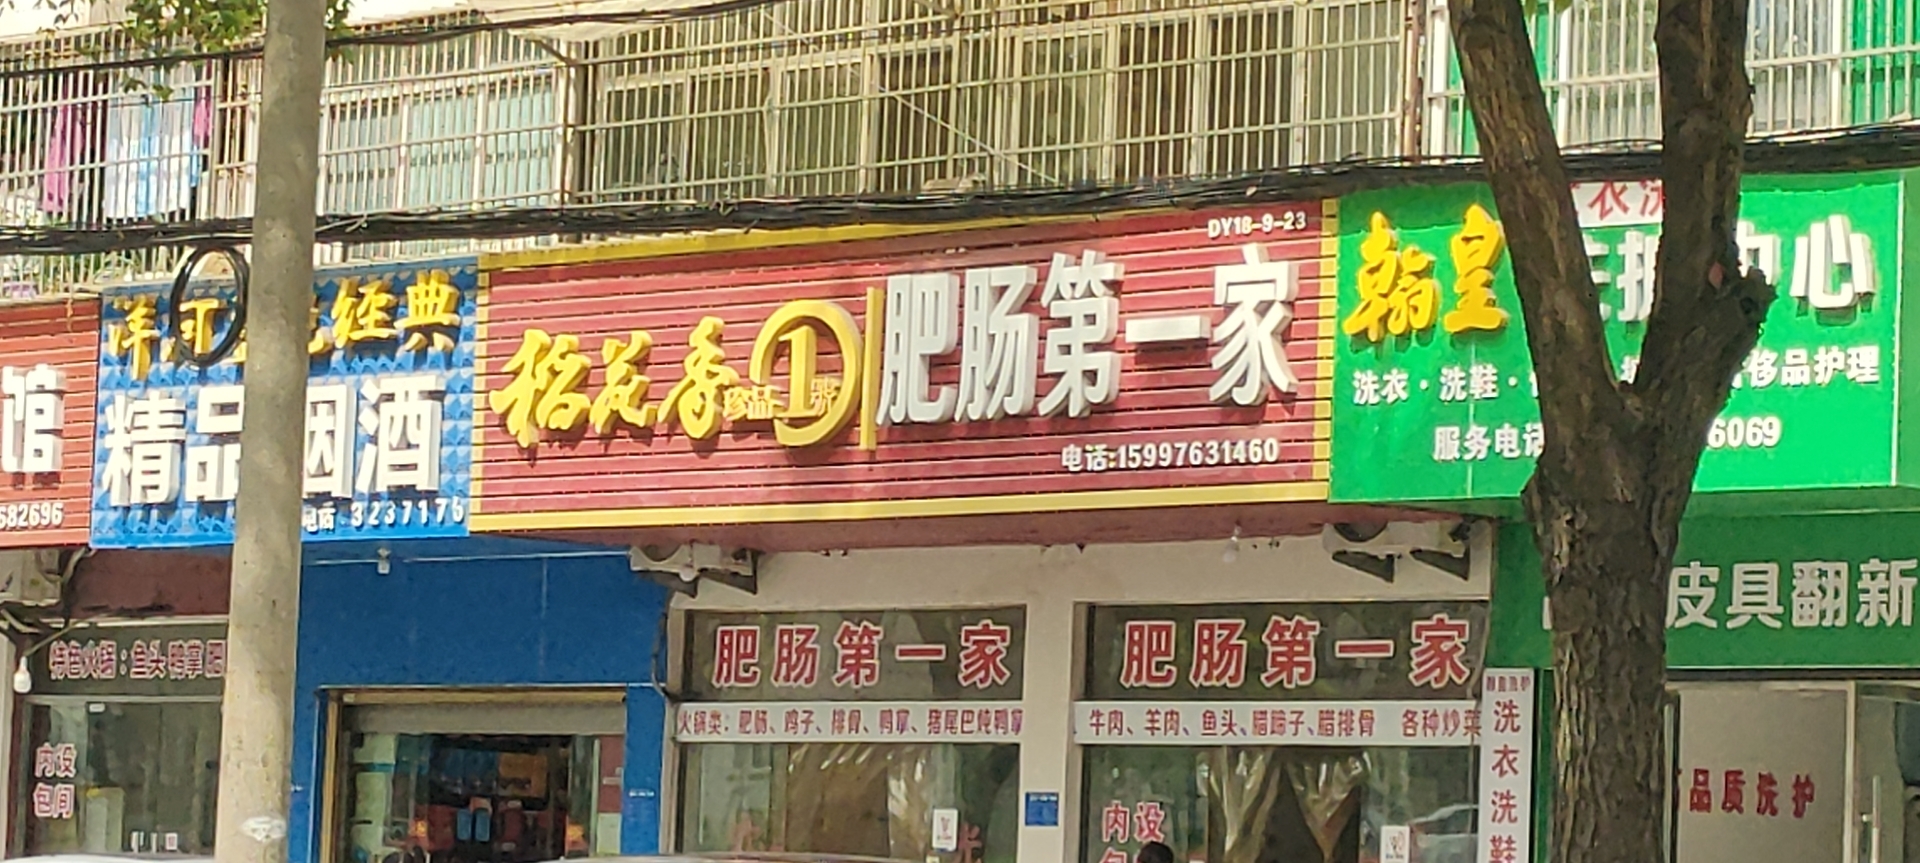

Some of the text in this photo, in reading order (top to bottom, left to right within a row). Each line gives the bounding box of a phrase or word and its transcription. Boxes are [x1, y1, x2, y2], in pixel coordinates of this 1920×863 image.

[1207, 210, 1307, 239] DY18-9-23
[1343, 204, 1508, 343] 翰皇
[876, 248, 1300, 427] 肥肠第一家
[1732, 344, 1881, 389] 侈品护理
[489, 315, 735, 448] 稻花香
[2, 363, 66, 472] 馆
[1061, 437, 1280, 471] 电话:15997631460
[1664, 558, 1918, 631] 皮具翻新
[712, 620, 1011, 688] 肥肠第一家
[1120, 613, 1471, 689] 肥肠第一家
[1401, 708, 1482, 738] 各种炒菜
[34, 742, 77, 778] 内设
[1102, 801, 1165, 843] 内设
[1677, 768, 1815, 819] 品质洗护
